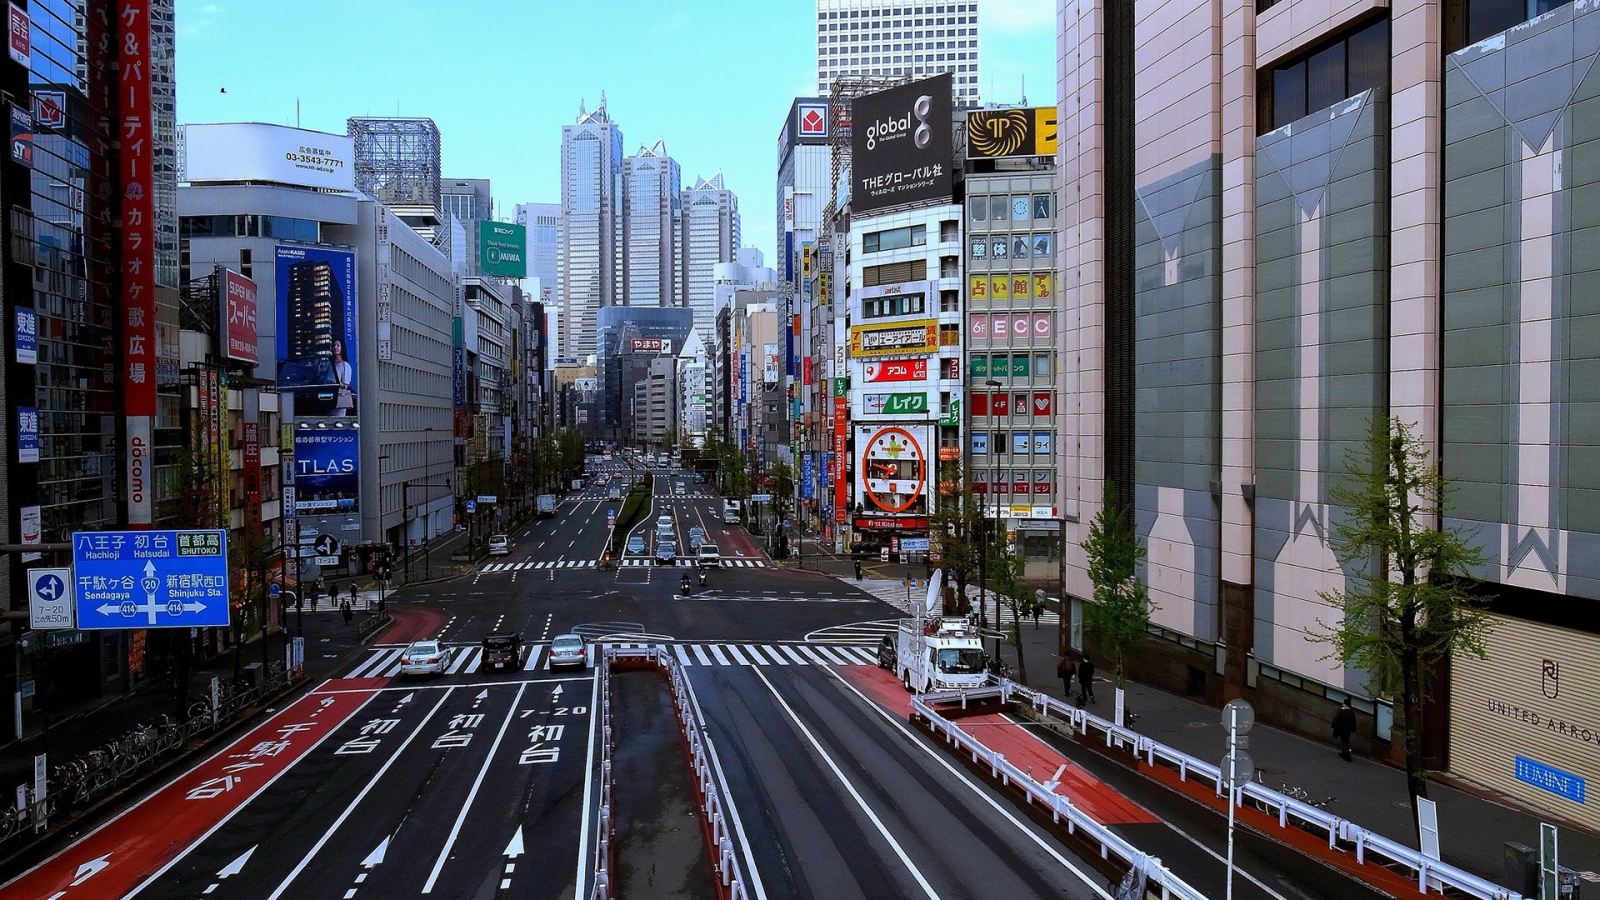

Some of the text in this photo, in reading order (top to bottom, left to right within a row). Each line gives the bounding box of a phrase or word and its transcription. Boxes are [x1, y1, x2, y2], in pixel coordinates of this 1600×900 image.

[866, 112, 911, 151] global
[286, 153, 344, 168] 03-3543-7771
[862, 164, 943, 190] THEグローバル社
[972, 280, 1028, 296] 占い館
[128, 208, 146, 383] カラオケ歌広場
[17, 312, 35, 335] 東進
[972, 321, 986, 333] 6F
[995, 319, 1049, 333] ECC
[634, 340, 660, 349] やまや
[888, 366, 907, 375] アコム
[915, 361, 924, 369] 6F
[893, 396, 922, 409] レイク
[20, 412, 38, 433] 東進
[132, 436, 146, 504] docomo
[297, 458, 354, 473] TLAS
[79, 535, 126, 550] 八王子
[134, 535, 168, 549] 初台
[178, 534, 220, 547] 首都高
[86, 551, 120, 560] Hachioji
[134, 550, 170, 558] Hatsudai
[181, 547, 217, 556] SHUTOKO
[145, 581, 156, 590] 20
[166, 574, 224, 588] 新宿駅西口
[84, 591, 130, 601] Sendagaya
[168, 588, 223, 599] Shinjuku Sta.
[38, 606, 64, 614] 7-20
[122, 605, 135, 613] 414
[169, 604, 182, 612] 414
[34, 614, 70, 624] この先50m
[1488, 699, 1540, 726] UNITED
[333, 718, 402, 755] 初台
[431, 713, 485, 749] 初台
[518, 724, 565, 765] 初台
